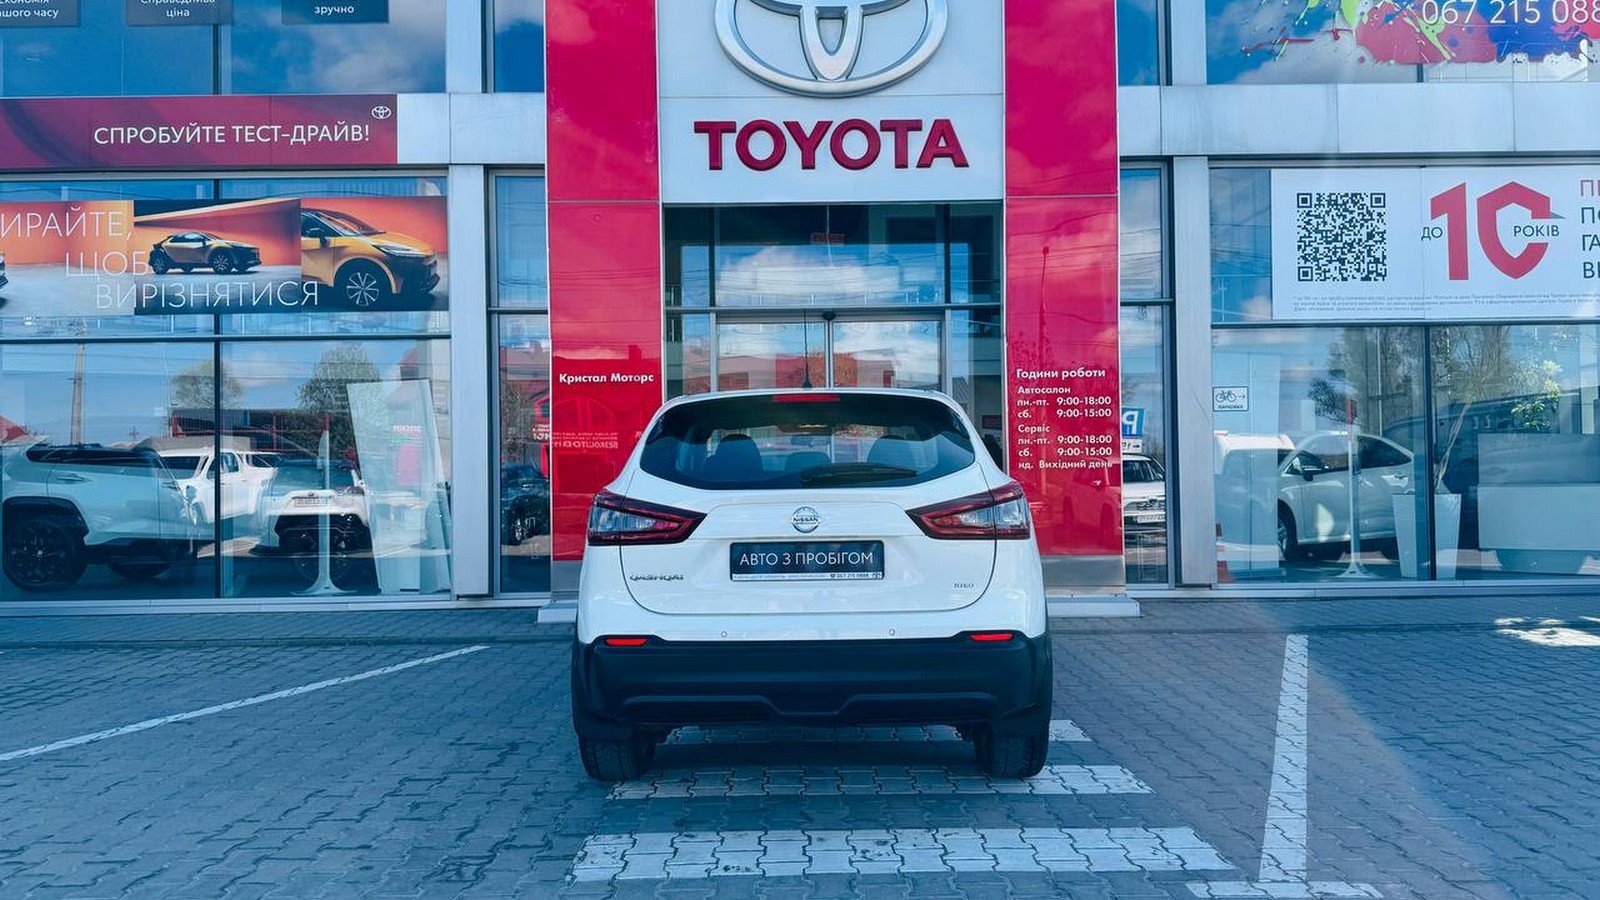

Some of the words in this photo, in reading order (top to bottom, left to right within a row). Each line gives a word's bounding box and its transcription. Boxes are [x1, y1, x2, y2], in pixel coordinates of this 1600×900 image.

[0, 9, 31, 17] шого
[34, 9, 59, 19] часу
[166, 8, 190, 18] ціна
[314, 6, 355, 16] зручно
[1422, 0, 1476, 24] 067
[1490, 0, 1541, 24] 215
[93, 123, 226, 146] СПРОБУЙТЕ
[231, 121, 370, 145] ТЕСТ-ДРАЙВ!
[693, 118, 970, 172] TOYOTA
[1580, 180, 1600, 196] П
[1421, 226, 1443, 241] ДО
[1513, 225, 1560, 238] РОКІВ
[65, 250, 149, 281] ЩОБ
[1583, 261, 1600, 279] В
[96, 281, 319, 309] ВИРІЗНЯТИСЯ
[559, 373, 607, 385] Кристал
[610, 372, 655, 384] Моторс
[1016, 368, 1058, 379] Години
[1061, 367, 1106, 380] роботи
[1017, 386, 1071, 394] Автосалон
[1056, 396, 1112, 405] 9:00-18:00
[1017, 409, 1032, 418] сб.
[1056, 408, 1112, 417] 9:00-15:00
[1018, 423, 1051, 434] Сервіс
[1057, 435, 1113, 444] 9:00-18:00
[1018, 447, 1033, 457] сб.
[1057, 447, 1113, 456] 9:00-15:00
[1039, 460, 1087, 469] Вихідний
[739, 553, 779, 566] АВТО
[782, 553, 791, 566] З
[795, 552, 874, 566] ПРОБІГОМ
